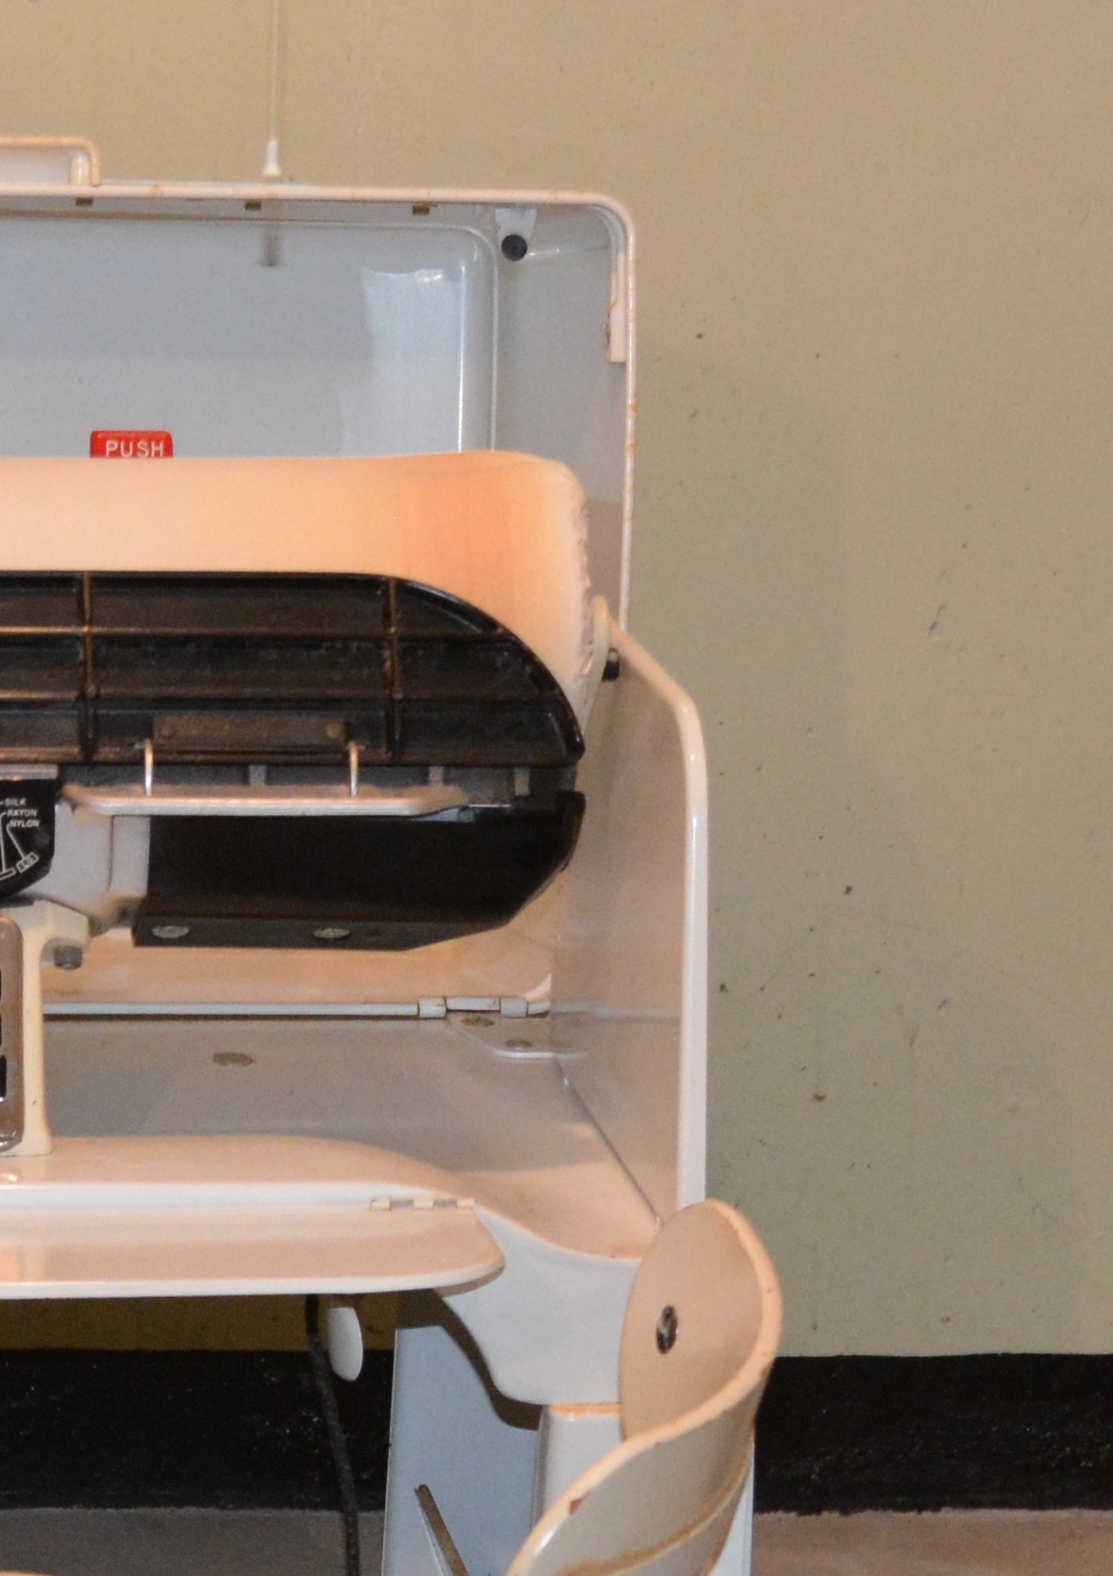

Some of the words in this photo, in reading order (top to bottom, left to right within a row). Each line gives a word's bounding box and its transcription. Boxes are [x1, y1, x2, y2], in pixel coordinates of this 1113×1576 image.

[105, 439, 165, 458] PUSH
[5, 797, 26, 806] SILK
[7, 809, 37, 817] RAYON
[10, 819, 40, 828] NYLON
